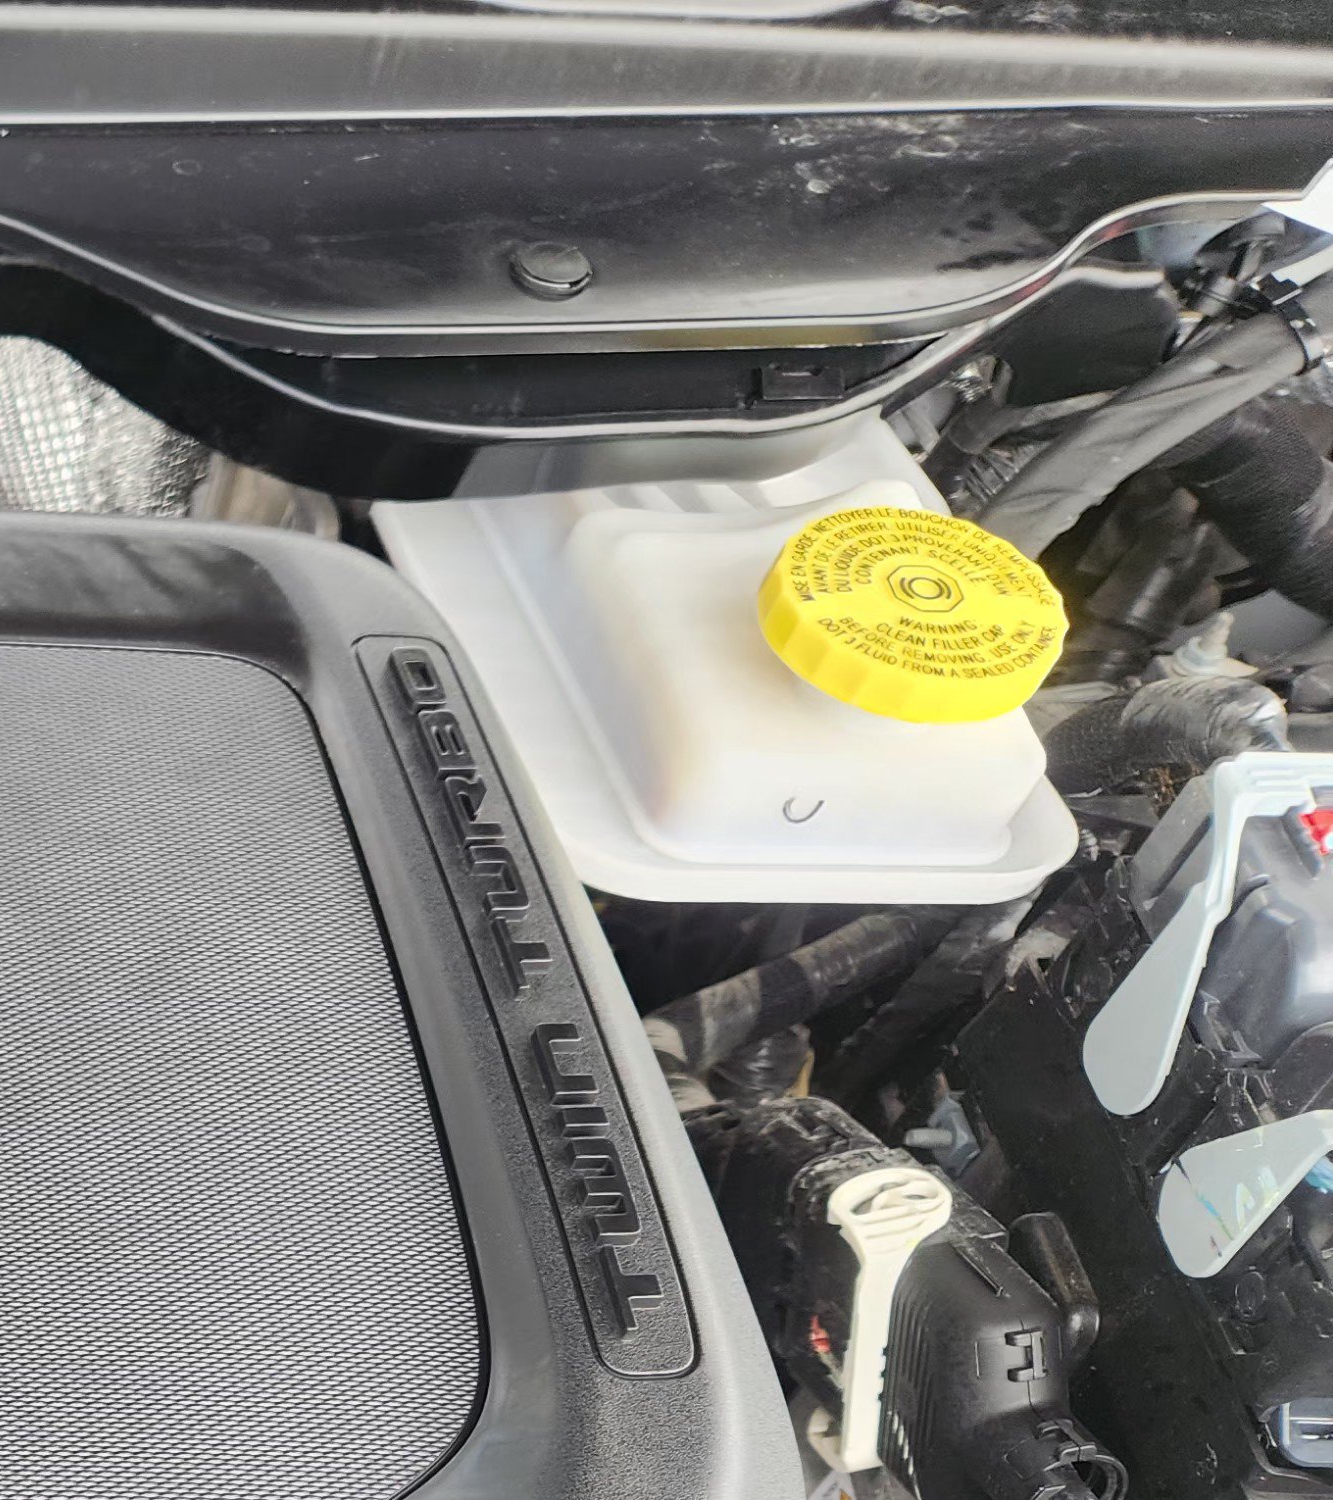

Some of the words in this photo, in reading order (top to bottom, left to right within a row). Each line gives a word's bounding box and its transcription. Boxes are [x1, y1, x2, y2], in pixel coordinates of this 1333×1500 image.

[813, 508, 874, 534] NETTOYER
[876, 508, 894, 518] LE
[898, 508, 968, 533] BOUCHON
[858, 535, 887, 549] DOT
[890, 533, 901, 542] 3
[895, 521, 958, 541] UTILISER
[973, 530, 990, 543] DE
[792, 534, 817, 562] GARDE
[814, 550, 832, 562] DE
[822, 538, 841, 551] LE
[791, 565, 807, 577] EN
[833, 544, 862, 577] LIQUIDE
[854, 546, 919, 585] CONTENANT
[793, 581, 815, 601] MISE
[813, 563, 834, 594] AVANT
[833, 578, 853, 593] DU
[817, 618, 848, 637] DOT
[844, 637, 857, 645] 3
[854, 642, 898, 665] FLUID
[901, 660, 946, 677] FROM
[950, 669, 961, 678] A
[962, 662, 1016, 679] SEALED
[839, 617, 895, 652] BEFORE
[989, 642, 1018, 659] USE
[1011, 619, 1036, 645] ONLY
[876, 622, 926, 647] CLEAN
[933, 636, 984, 651] FILLER
[981, 624, 1004, 642] CAP
[383, 644, 556, 1001] TURBO
[530, 1020, 666, 1341] TWIN
